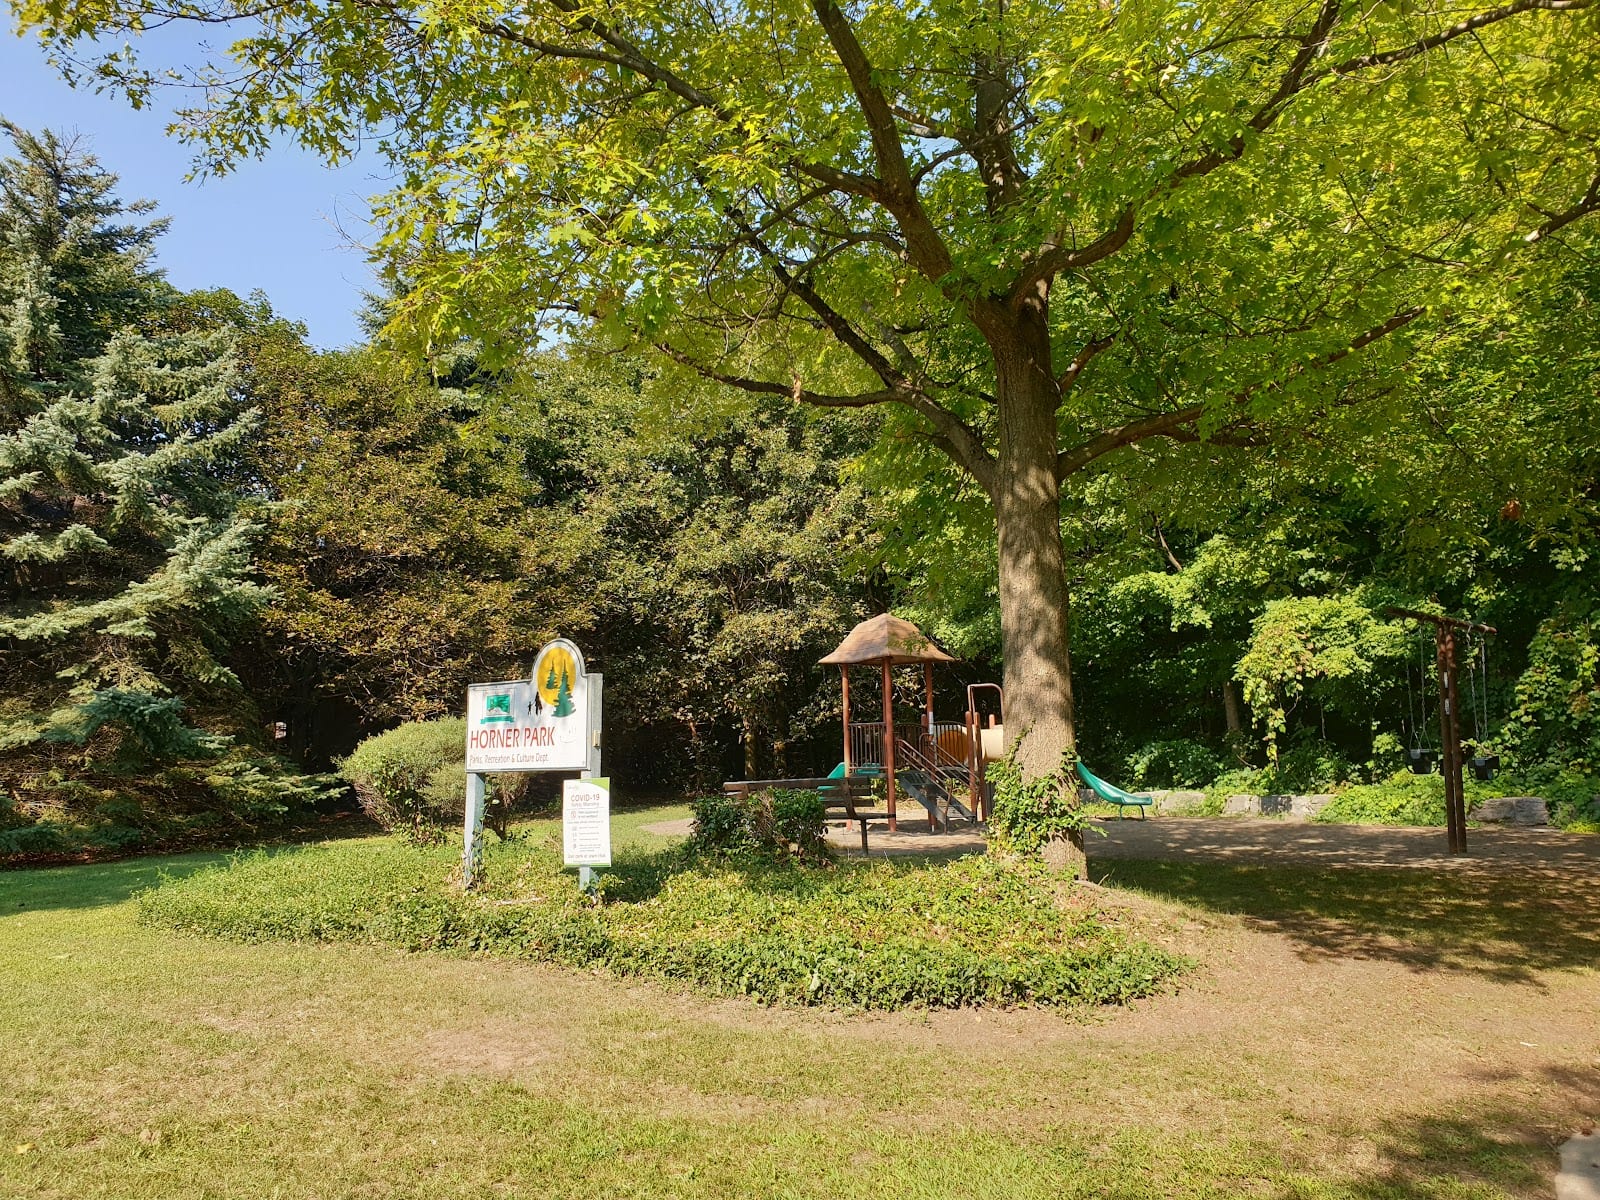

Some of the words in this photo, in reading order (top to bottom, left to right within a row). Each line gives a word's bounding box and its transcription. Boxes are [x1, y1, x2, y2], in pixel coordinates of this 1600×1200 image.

[470, 728, 520, 749] HORNER
[524, 726, 555, 747] PARK
[485, 754, 510, 764] Recreation
[511, 753, 515, 763] &
[516, 753, 534, 763] Culture
[571, 793, 600, 802] COVID-19
